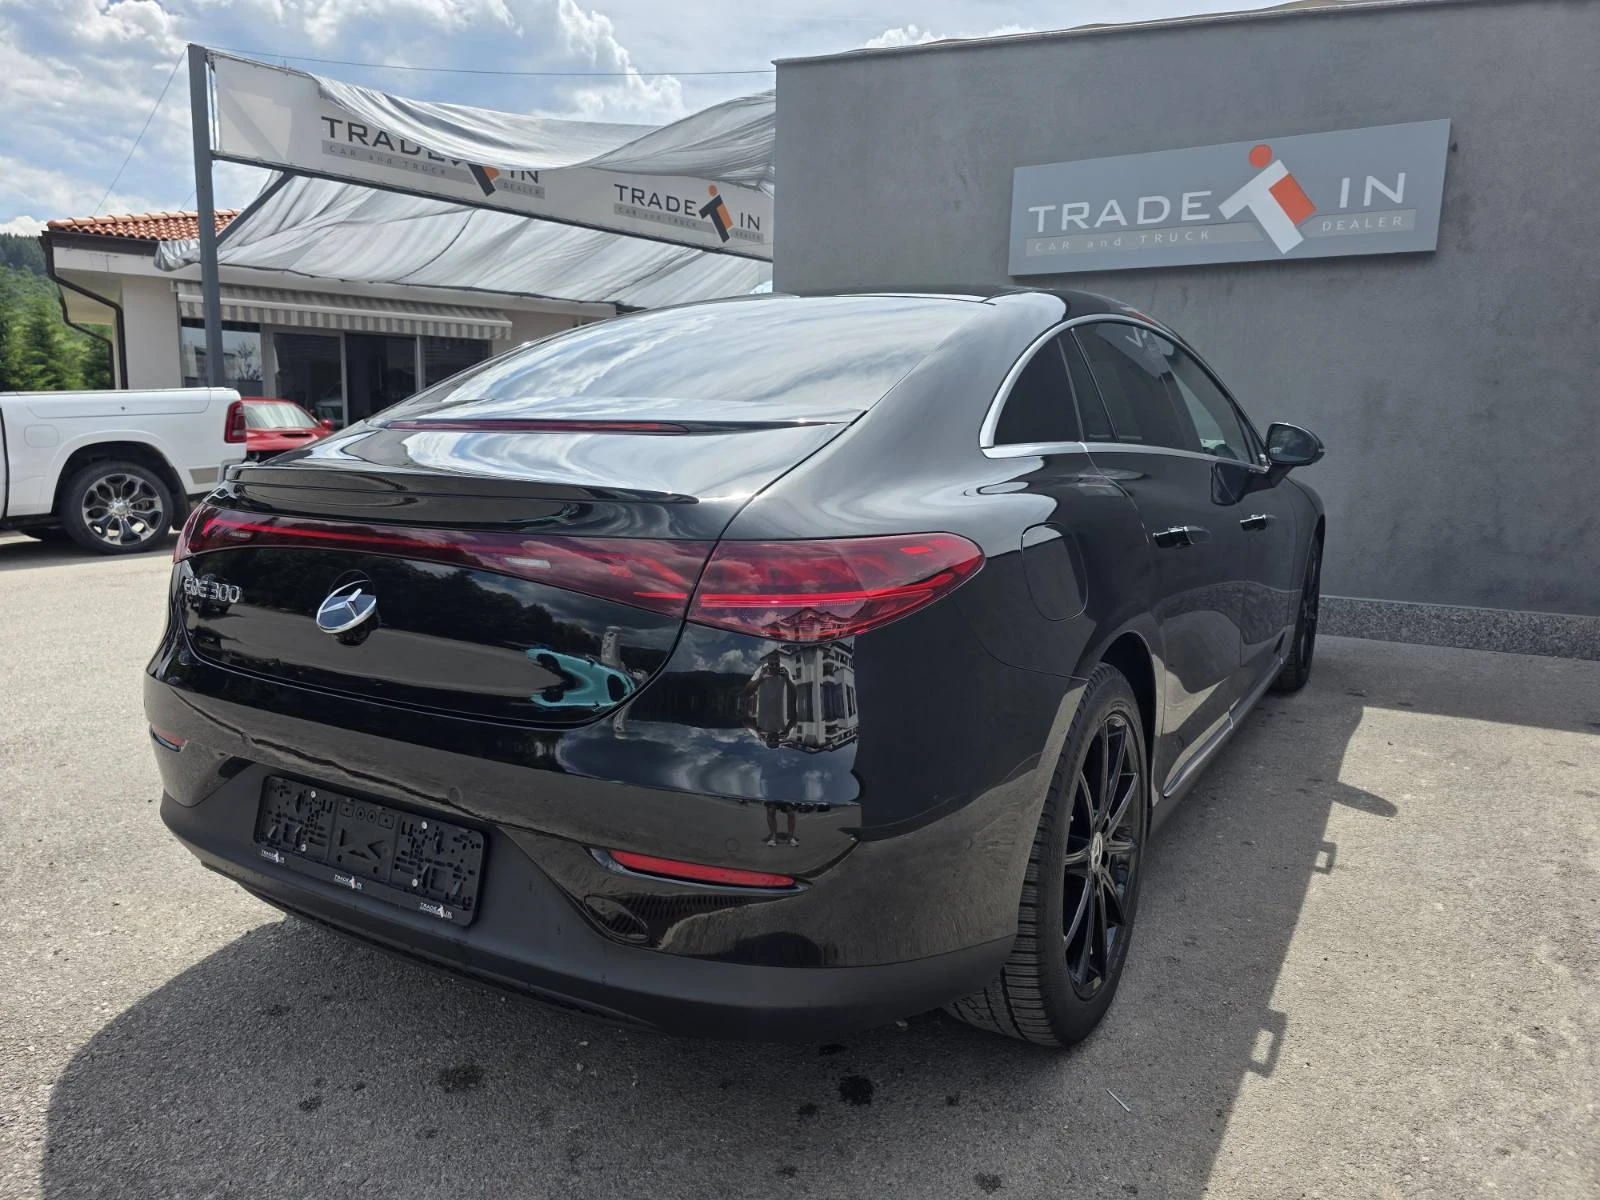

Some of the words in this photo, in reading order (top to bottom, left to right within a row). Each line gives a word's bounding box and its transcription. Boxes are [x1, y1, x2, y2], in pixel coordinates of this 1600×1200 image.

[329, 146, 357, 158] CAR
[403, 160, 446, 175] TRUCK
[614, 183, 697, 217] TRADE
[740, 212, 760, 231] IN
[1028, 190, 1212, 232] TRADE
[1339, 171, 1407, 209] IN
[1034, 240, 1071, 253] CAR
[1087, 236, 1122, 248] and
[1139, 229, 1210, 244] TRUCK
[1321, 215, 1403, 232] DEALER
[183, 577, 208, 598] EQE
[209, 581, 240, 604] 300
